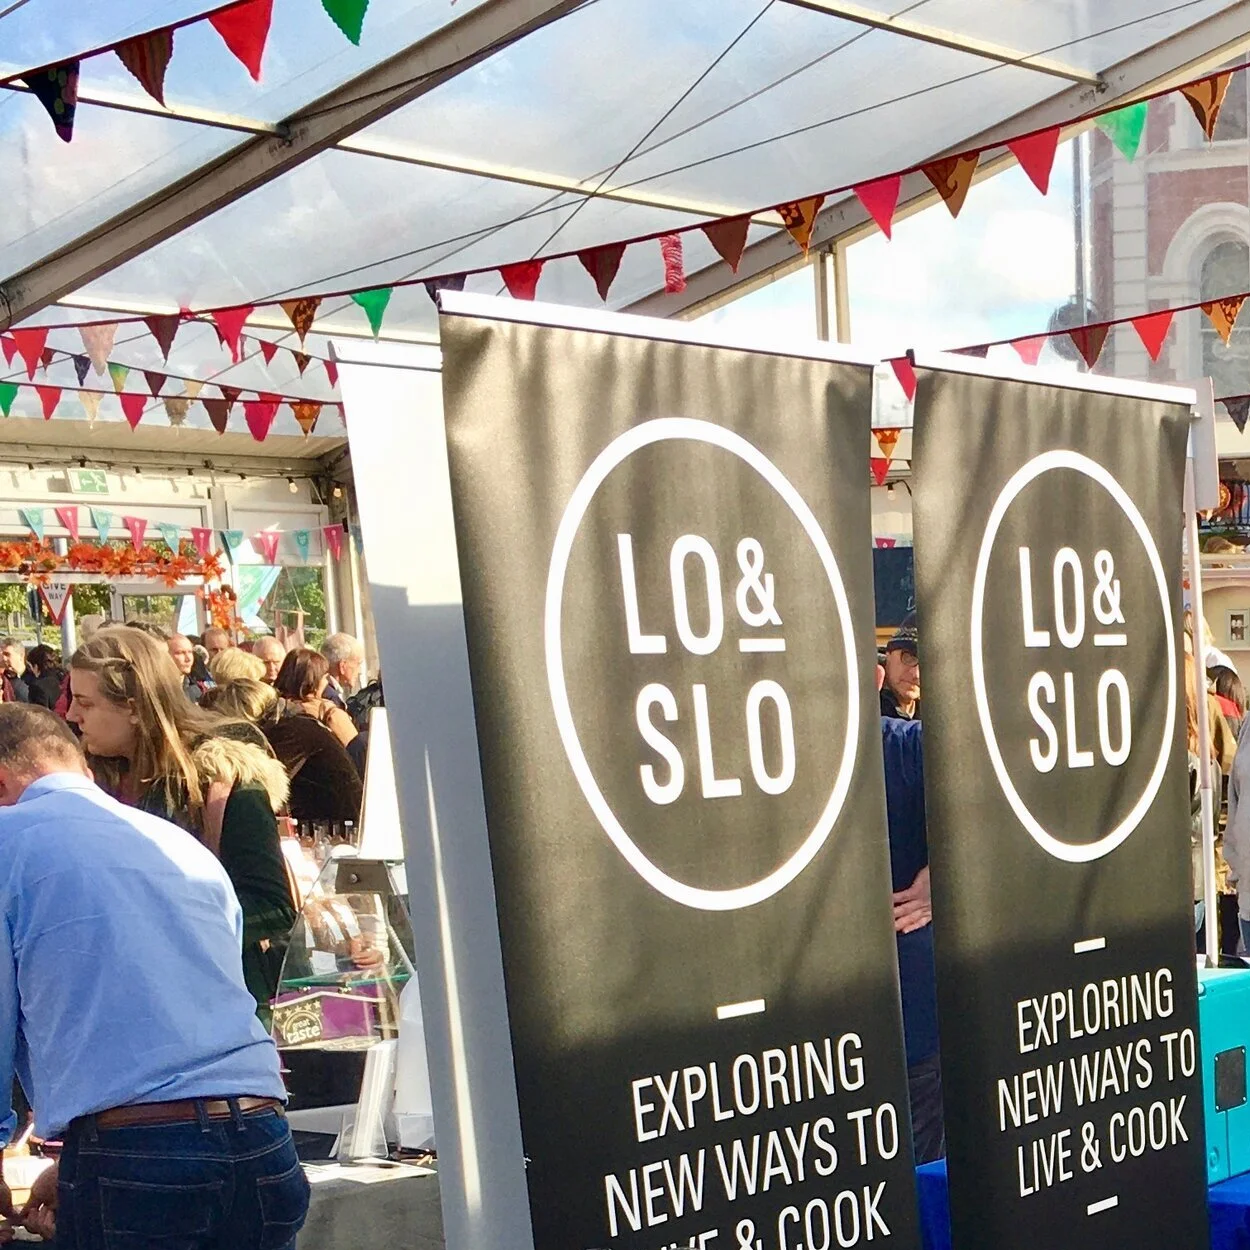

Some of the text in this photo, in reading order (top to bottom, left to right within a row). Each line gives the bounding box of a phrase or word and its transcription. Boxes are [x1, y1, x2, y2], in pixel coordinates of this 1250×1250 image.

[635, 679, 797, 805] SLO
[1027, 668, 1132, 773] SLO
[286, 1023, 321, 1044] taste
[1017, 967, 1175, 1055] EXPLORING
[631, 1032, 866, 1143] EXPLORING
[997, 1028, 1197, 1132] NEW WAYS TO
[604, 1102, 899, 1238] NEW WAYS TO
[1017, 1094, 1190, 1198] LIVE & COOK
